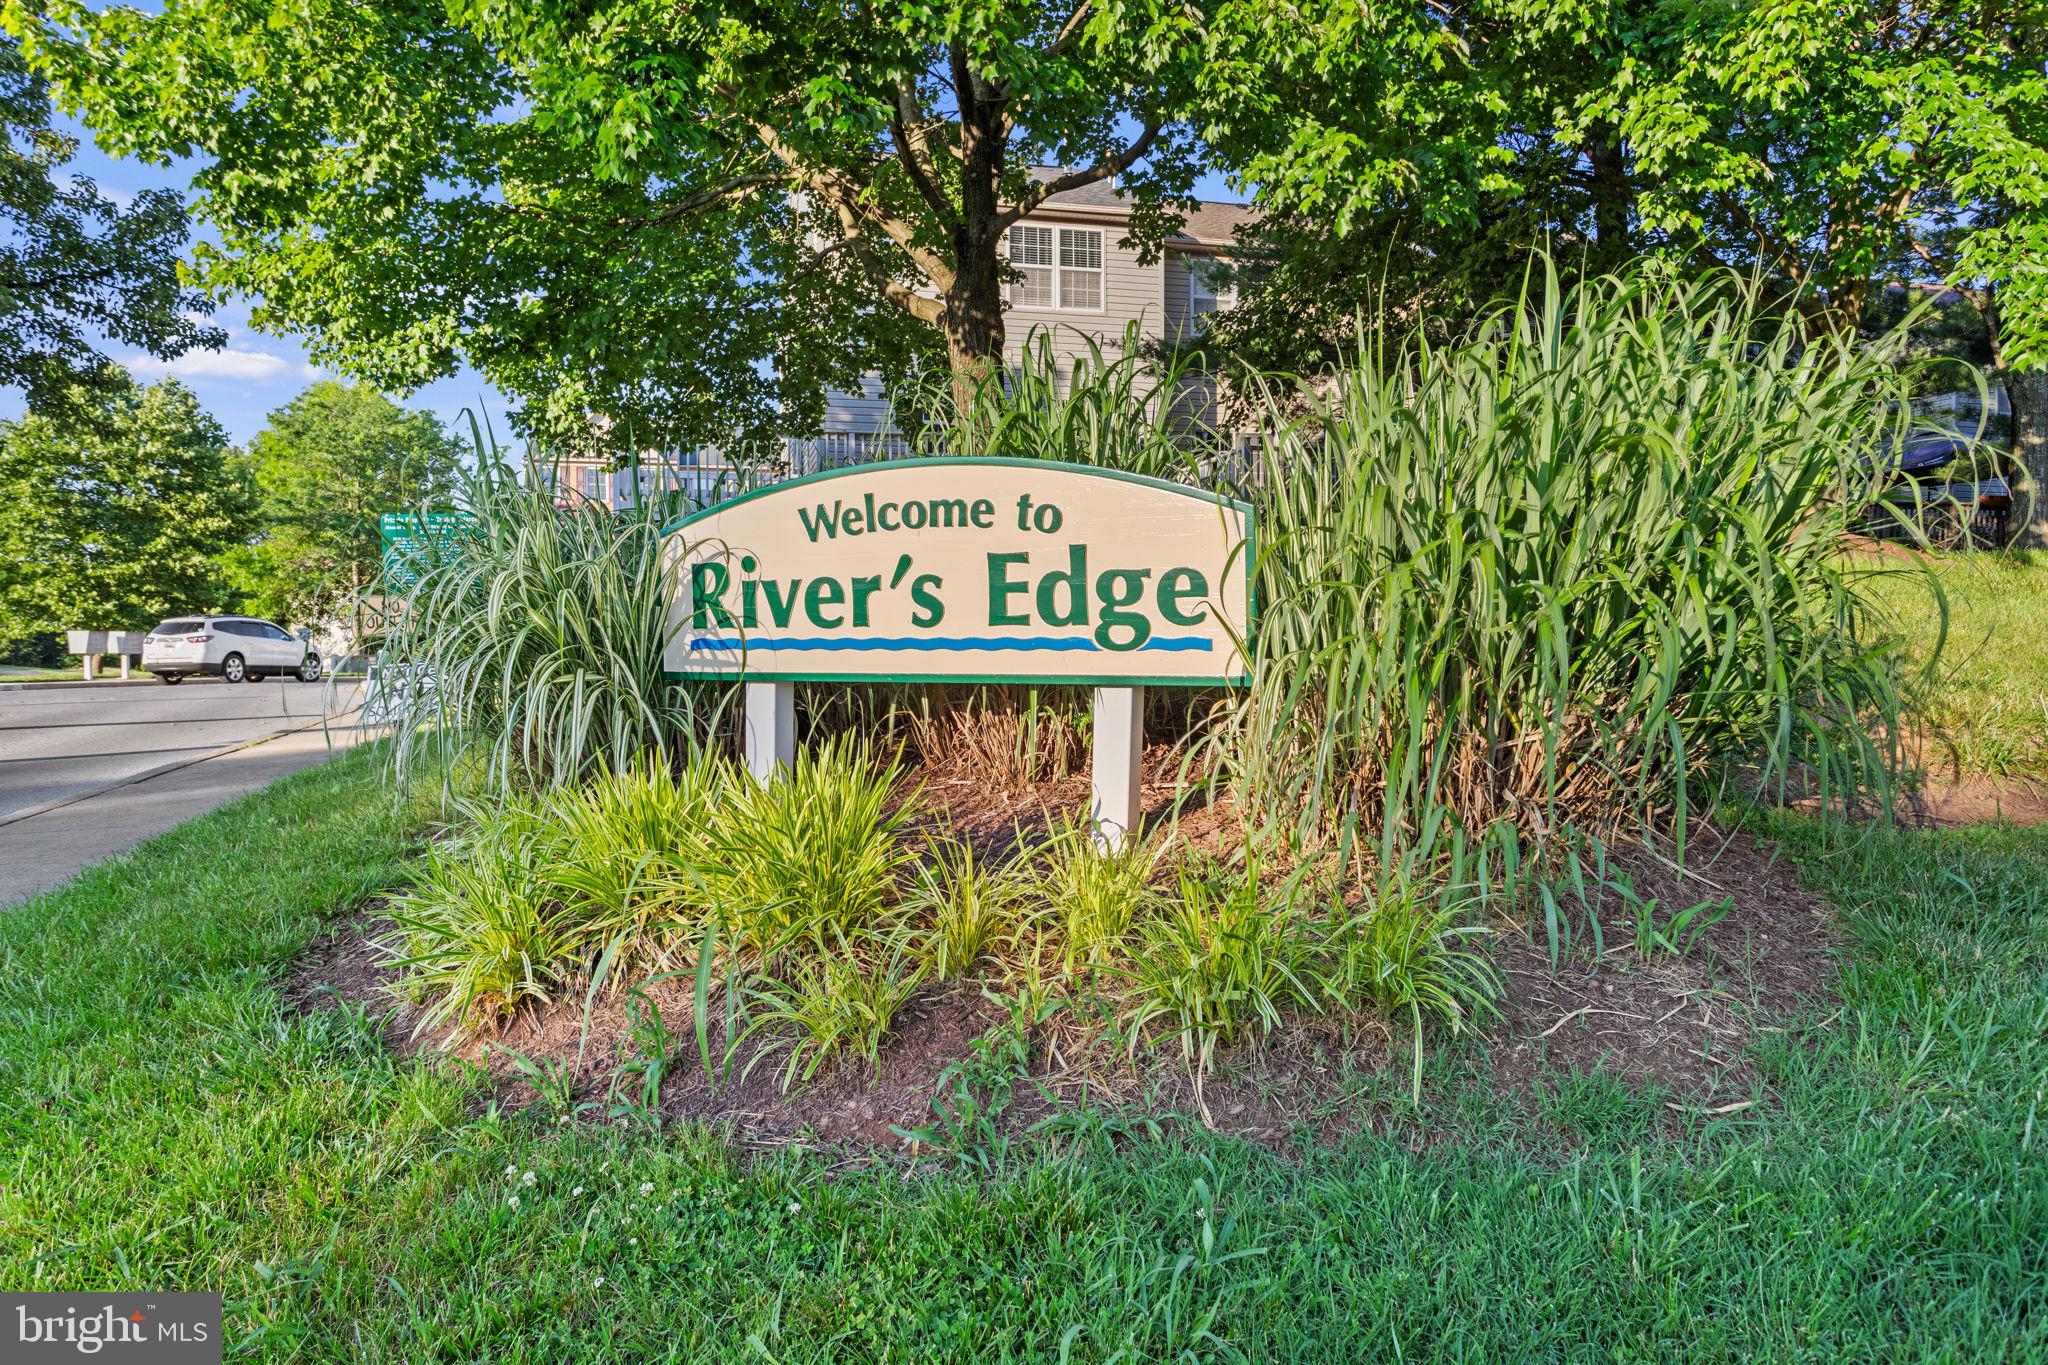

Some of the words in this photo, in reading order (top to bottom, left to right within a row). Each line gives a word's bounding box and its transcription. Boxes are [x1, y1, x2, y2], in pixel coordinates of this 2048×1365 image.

[798, 493, 995, 542] Welcome
[1016, 493, 1063, 534] to
[691, 554, 944, 630] River's
[987, 544, 1210, 652] Edge
